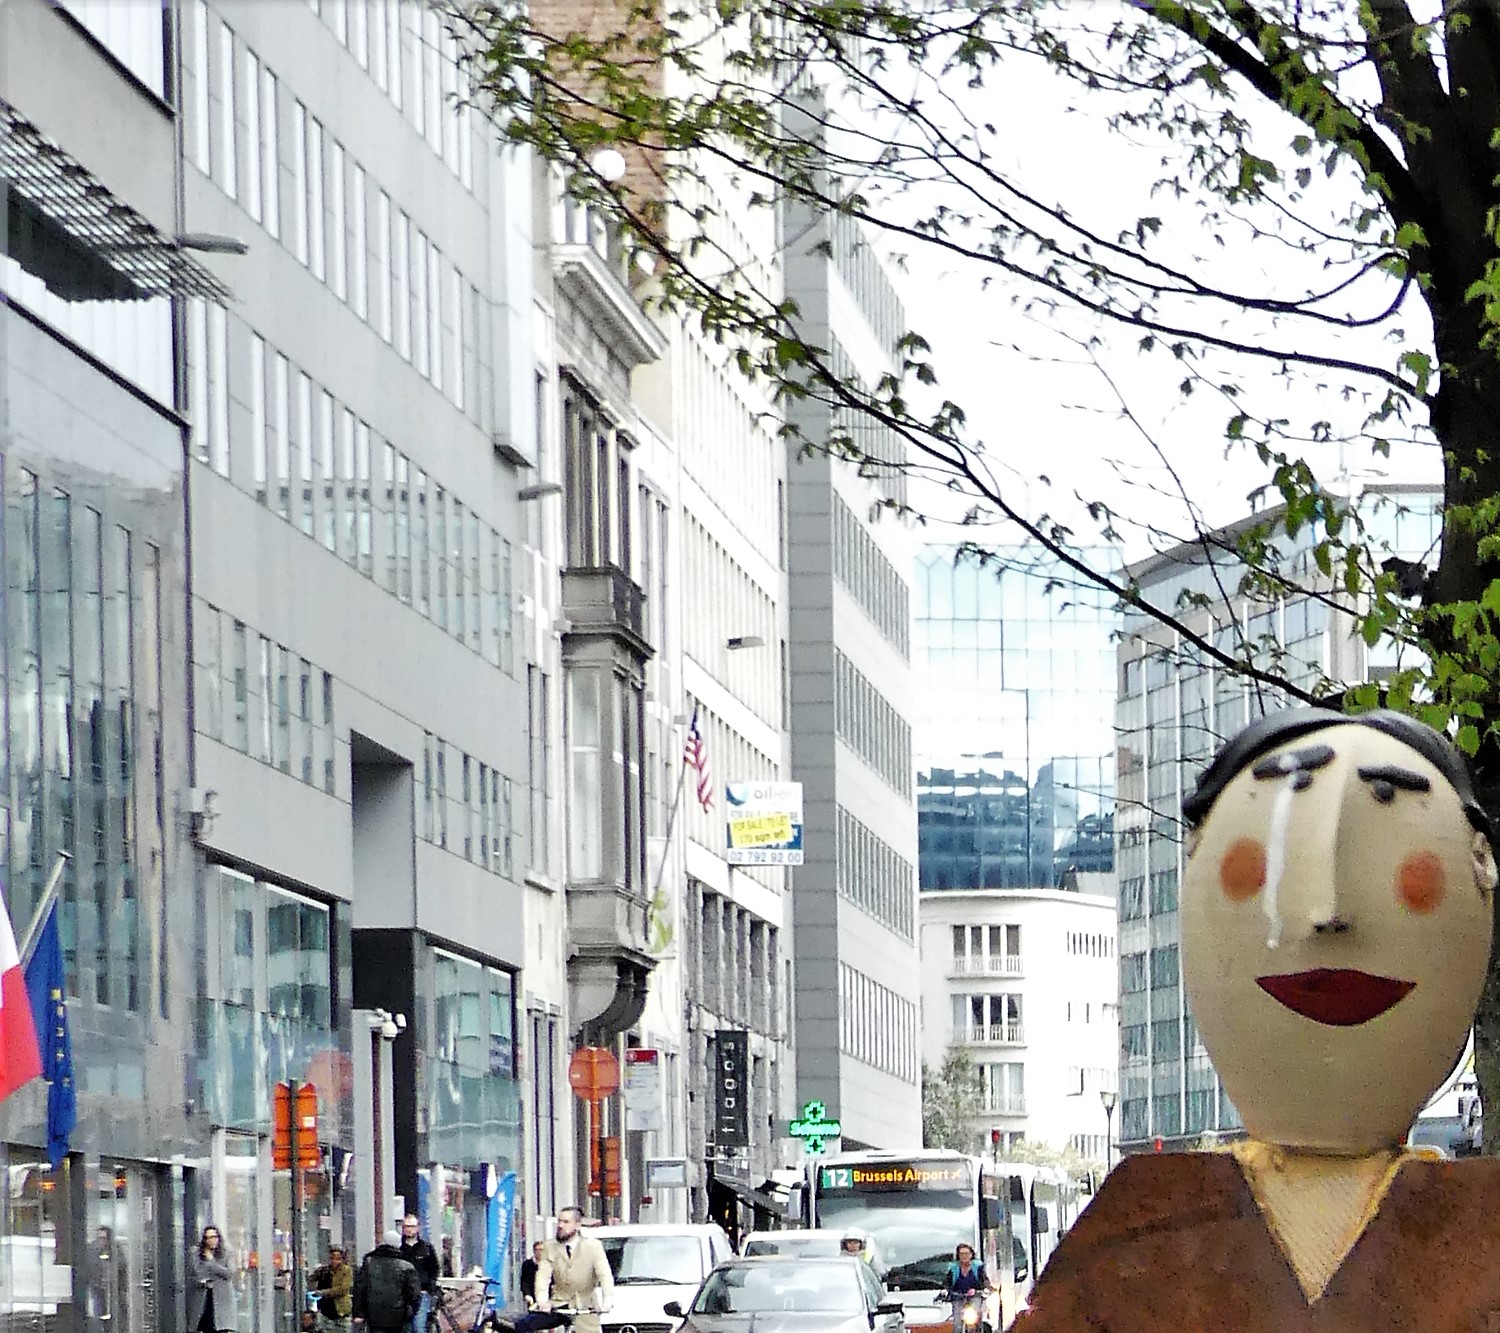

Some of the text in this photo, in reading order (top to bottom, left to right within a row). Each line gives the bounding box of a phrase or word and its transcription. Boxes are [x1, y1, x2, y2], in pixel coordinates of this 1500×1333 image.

[825, 1168, 949, 1187] 12 Brussels Airport
